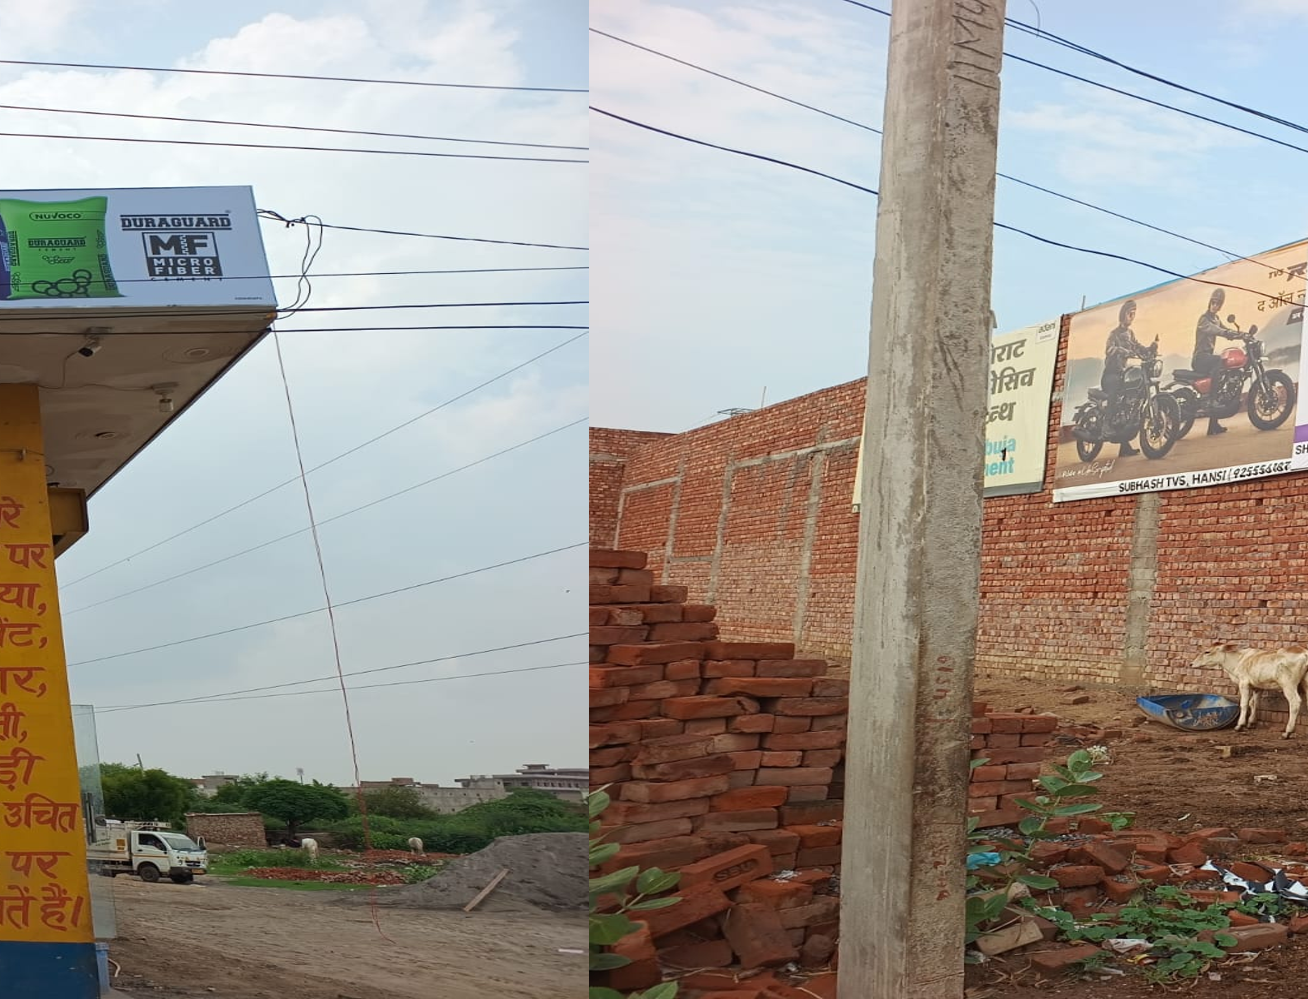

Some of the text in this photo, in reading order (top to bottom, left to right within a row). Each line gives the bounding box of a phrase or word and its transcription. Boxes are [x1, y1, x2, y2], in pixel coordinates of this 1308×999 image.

[33, 211, 83, 221] NUVOCO
[121, 213, 232, 232] DURAGUARD
[150, 234, 209, 256] MF
[151, 265, 215, 275] FIBER
[152, 257, 214, 266] MICRO
[1118, 469, 1227, 493] SUBHASH TVS, HANSI
[5, 543, 51, 570] पर
[2, 792, 80, 833] उचित
[6, 850, 71, 879] पर
